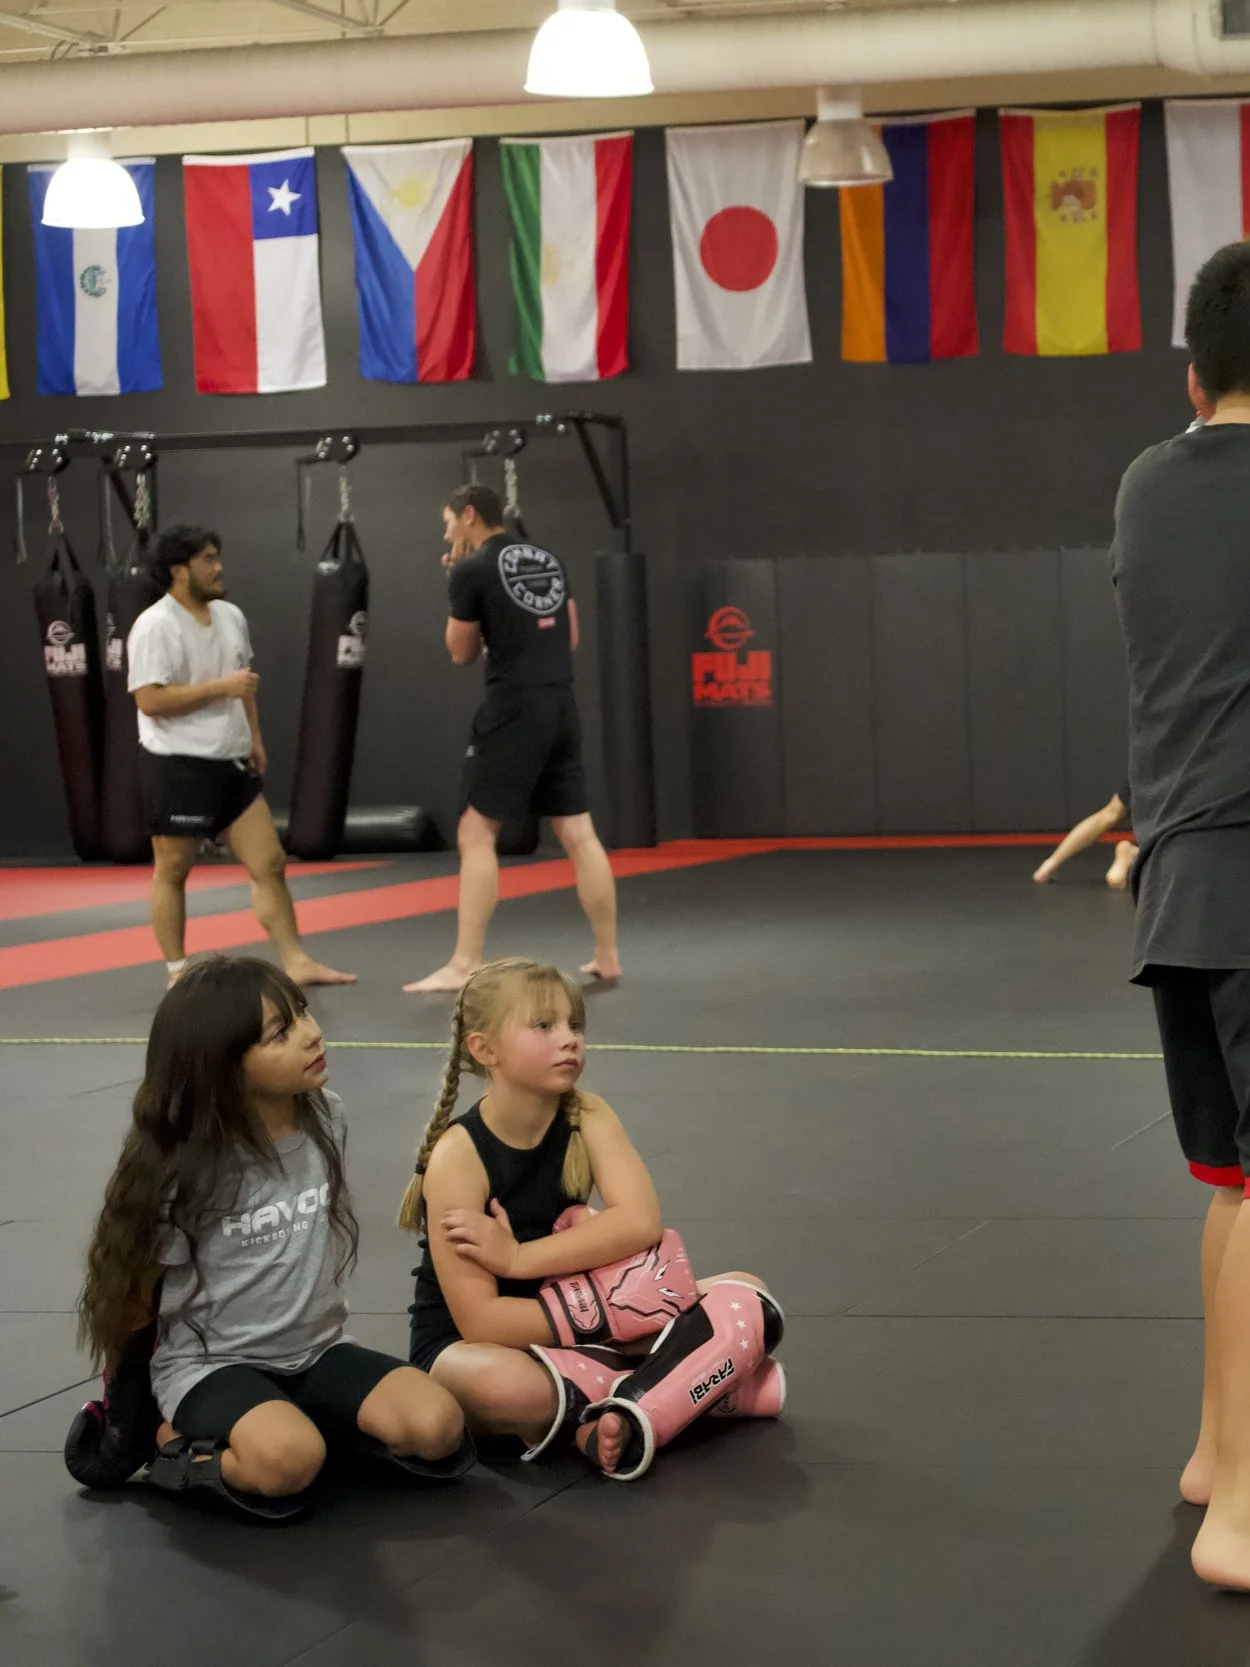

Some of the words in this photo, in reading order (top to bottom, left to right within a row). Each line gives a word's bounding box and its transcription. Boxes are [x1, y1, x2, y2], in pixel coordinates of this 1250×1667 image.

[504, 547, 560, 573] COMBAT
[512, 577, 563, 609] CORNER
[241, 1220, 308, 1248] KICKBONG
[688, 1357, 735, 1405] FARABI
